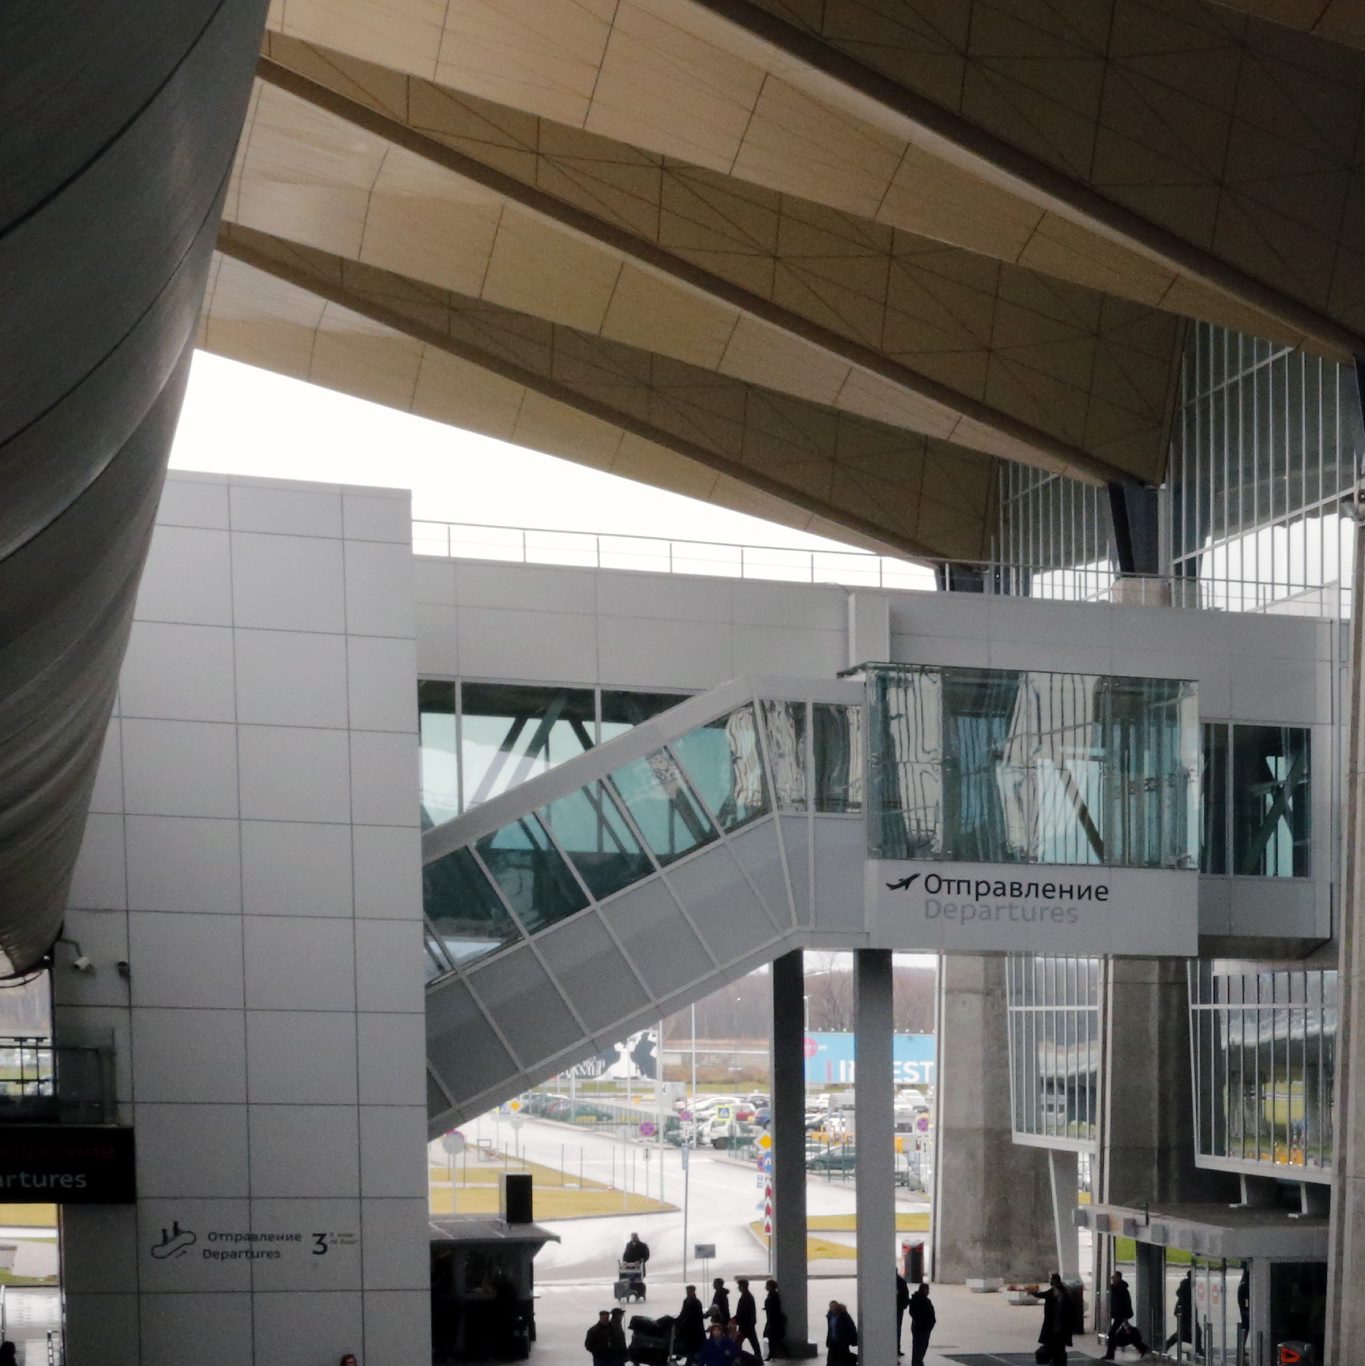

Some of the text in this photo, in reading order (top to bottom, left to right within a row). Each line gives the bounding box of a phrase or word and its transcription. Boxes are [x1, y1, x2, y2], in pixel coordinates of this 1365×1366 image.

[924, 873, 1109, 902] Отправление
[924, 899, 1079, 924] Departures
[207, 1231, 302, 1244] Отправление
[311, 1232, 328, 1255] 3
[203, 1248, 281, 1261] Departures
